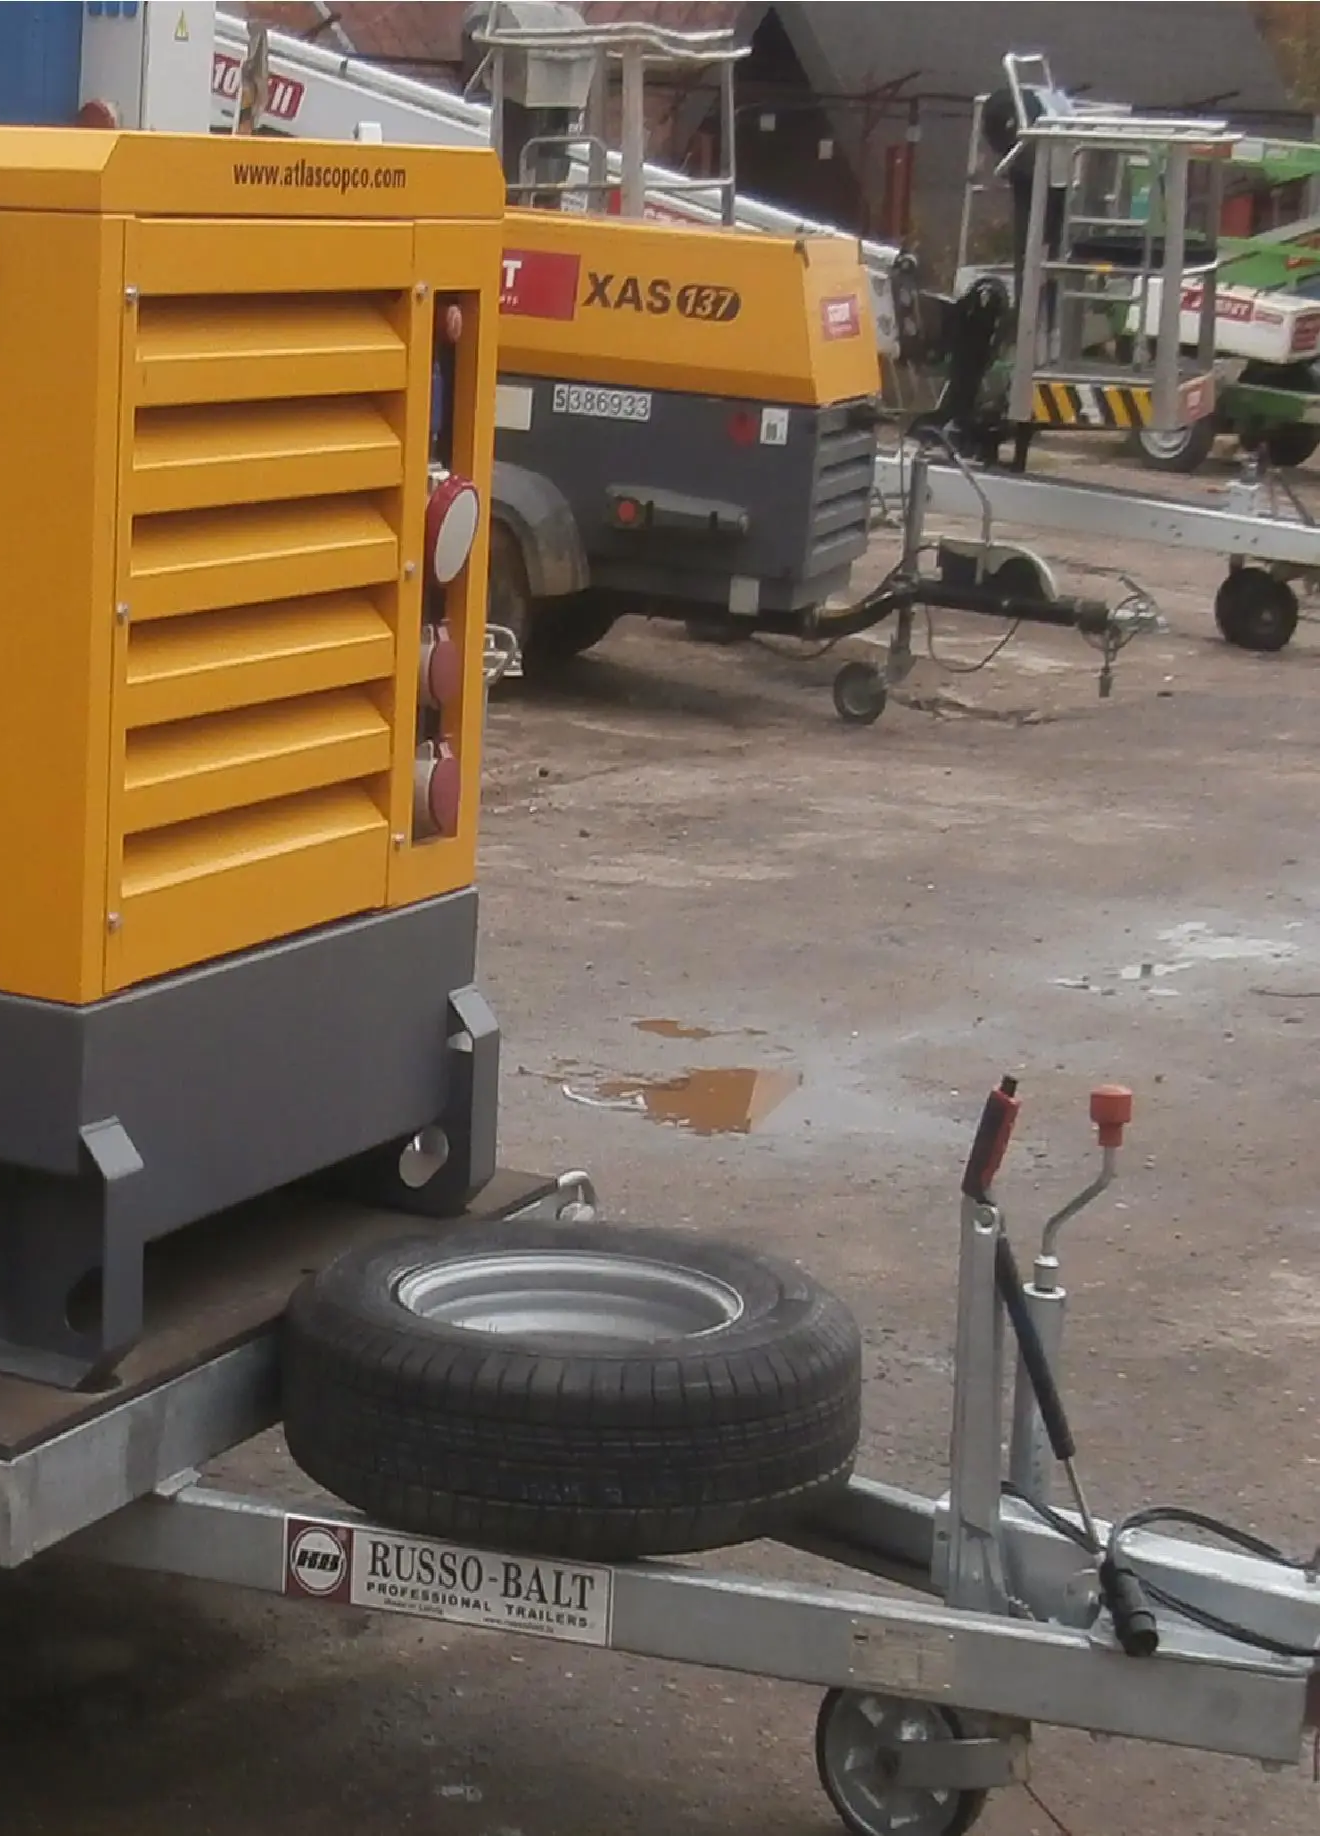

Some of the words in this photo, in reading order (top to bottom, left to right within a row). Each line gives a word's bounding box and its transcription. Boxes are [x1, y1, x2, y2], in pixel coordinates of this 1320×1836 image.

[233, 158, 407, 195] www.atlascopco.com
[582, 271, 672, 315] XAS
[683, 285, 736, 320] 137
[368, 1539, 595, 1611] RUSSO-BALT
[366, 1581, 492, 1613] PROFESSIONAL
[504, 1603, 589, 1629] TRAILERS
